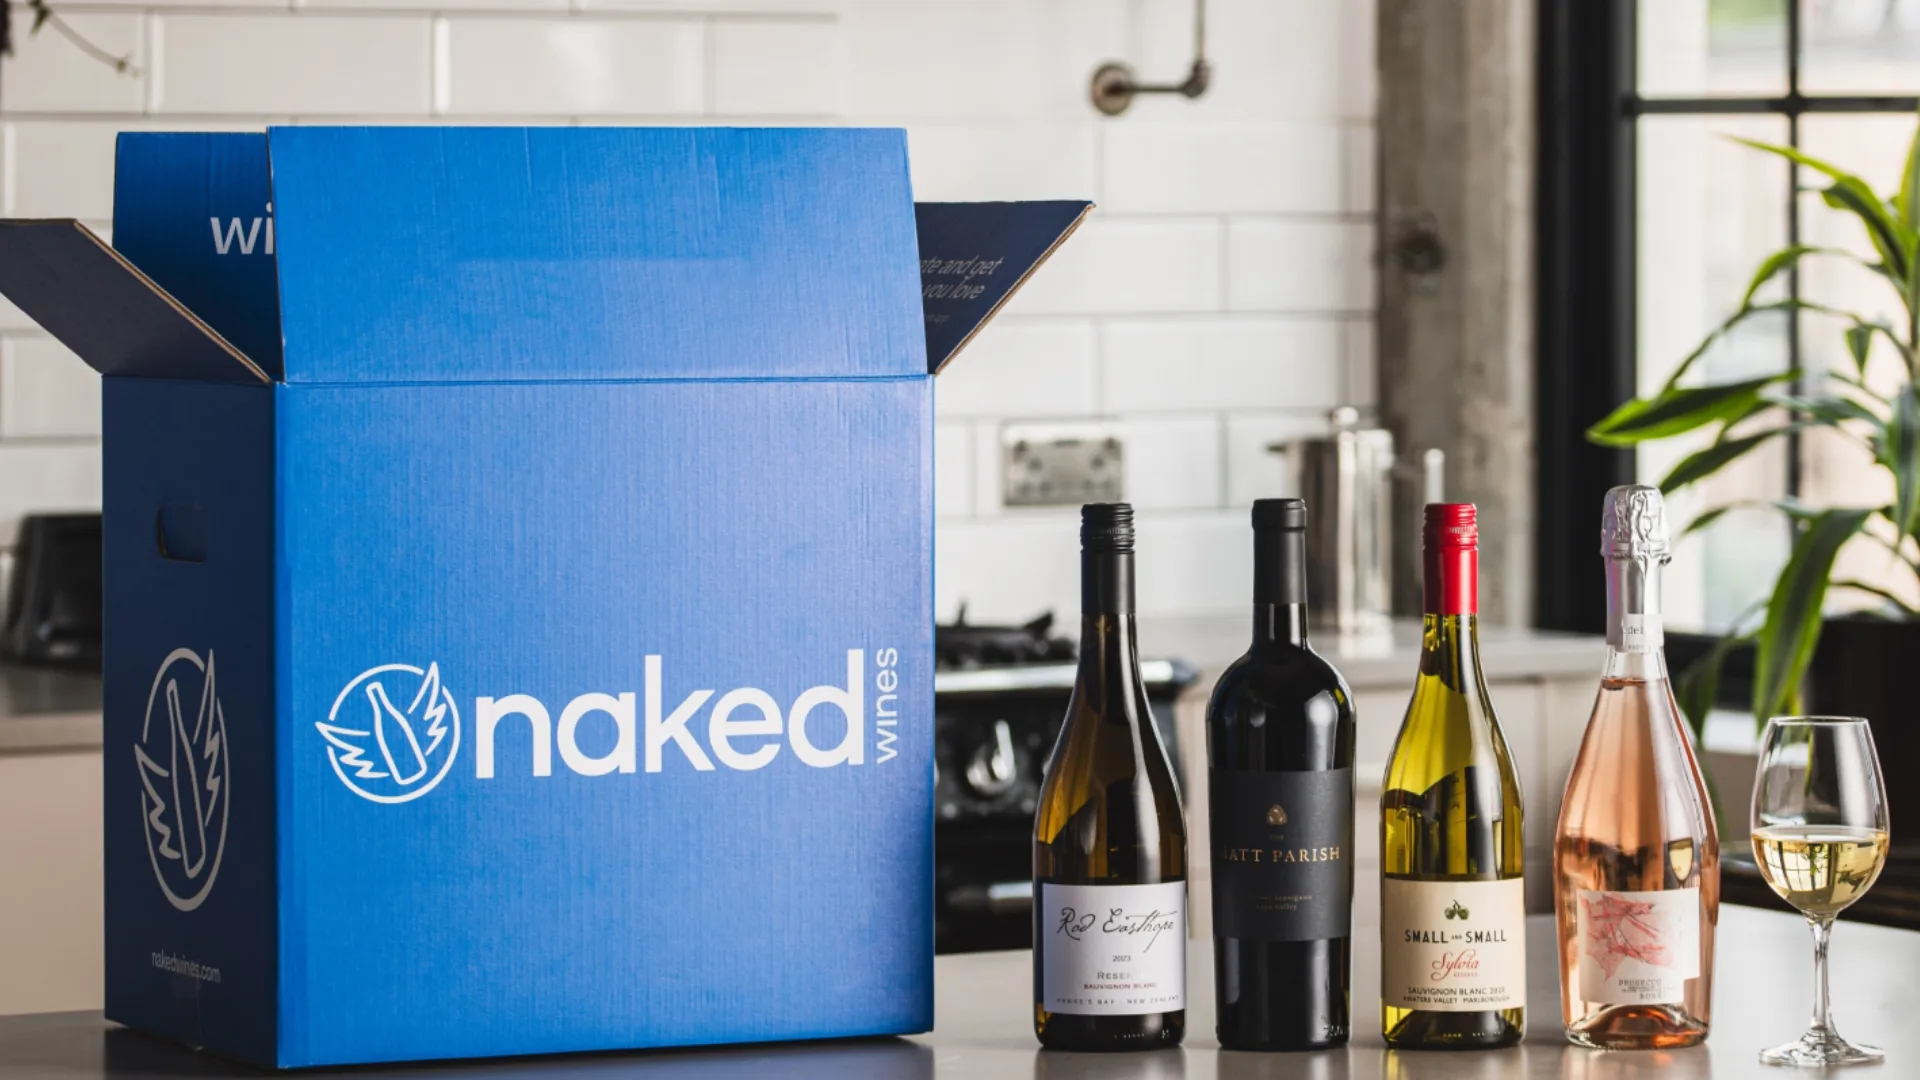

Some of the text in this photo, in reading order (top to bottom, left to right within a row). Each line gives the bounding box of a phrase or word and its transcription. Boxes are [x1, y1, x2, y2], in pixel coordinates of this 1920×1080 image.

[938, 253, 979, 276] and
[969, 255, 1005, 281] get
[947, 278, 985, 300] love
[476, 648, 864, 779] naked
[876, 646, 898, 764] wines
[1273, 846, 1340, 863] PARISH
[1056, 906, 1097, 941] Rod
[1404, 929, 1449, 944] SMALL
[1465, 929, 1507, 944] SMALL
[1430, 948, 1480, 982] Sylvia
[1083, 982, 1131, 991] SAUVIGNON
[1408, 986, 1457, 996] SAUVIGNON
[1459, 987, 1487, 996] BLANC
